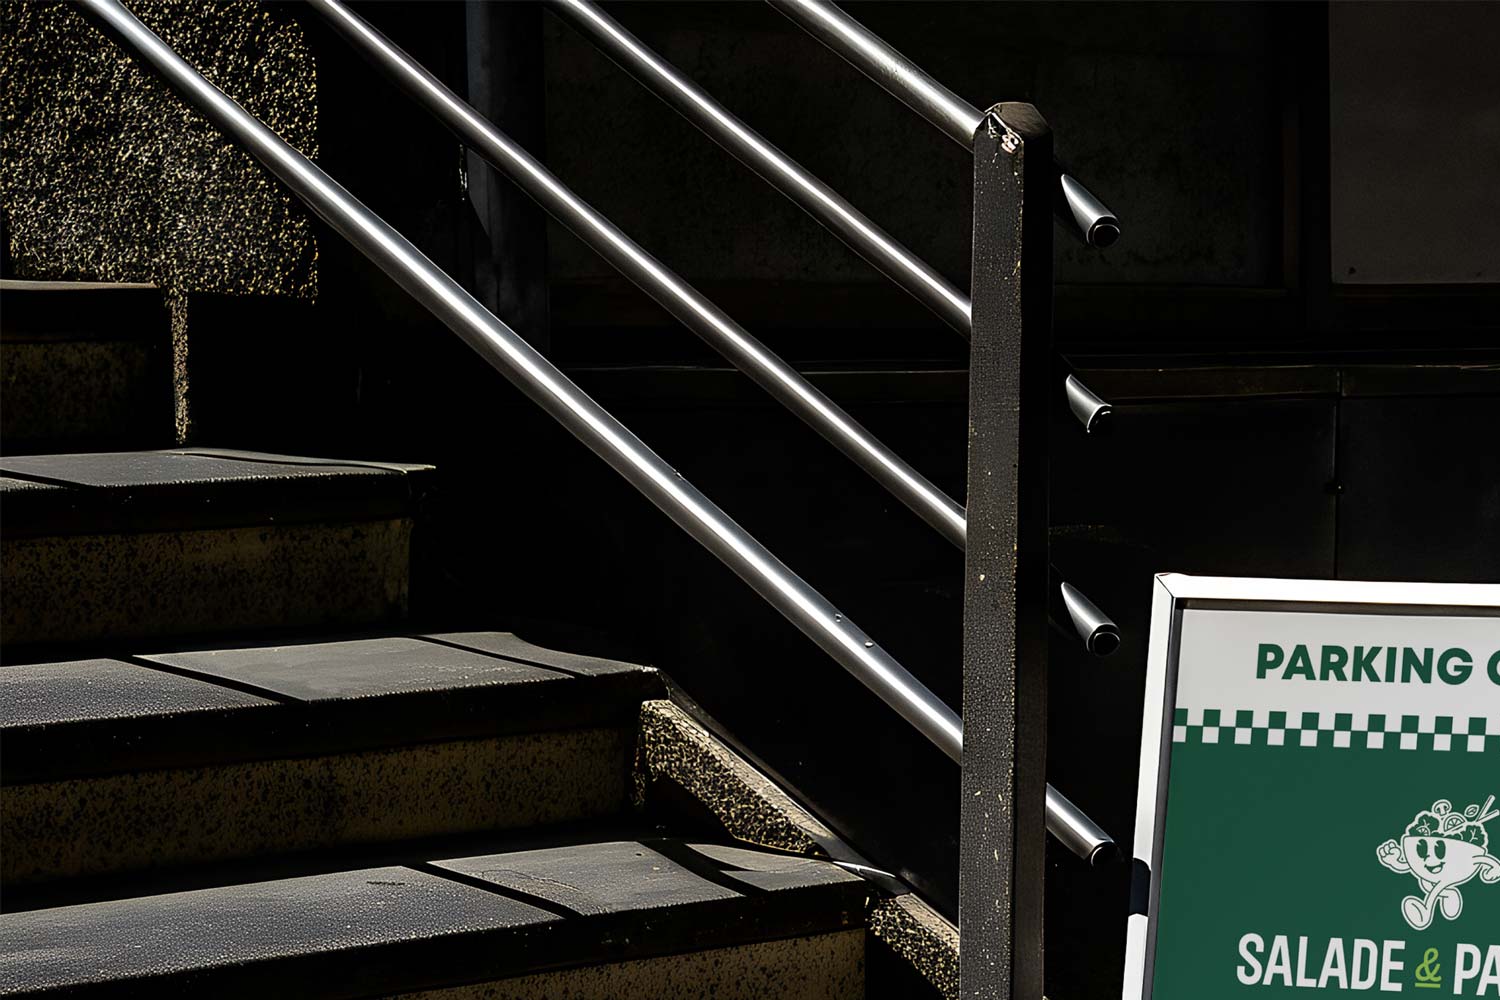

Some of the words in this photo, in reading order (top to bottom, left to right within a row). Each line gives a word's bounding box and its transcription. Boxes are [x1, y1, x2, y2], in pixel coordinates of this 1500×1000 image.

[1255, 643, 1474, 686] PARKING
[1236, 932, 1406, 992] SALADE
[1415, 948, 1442, 988] &
